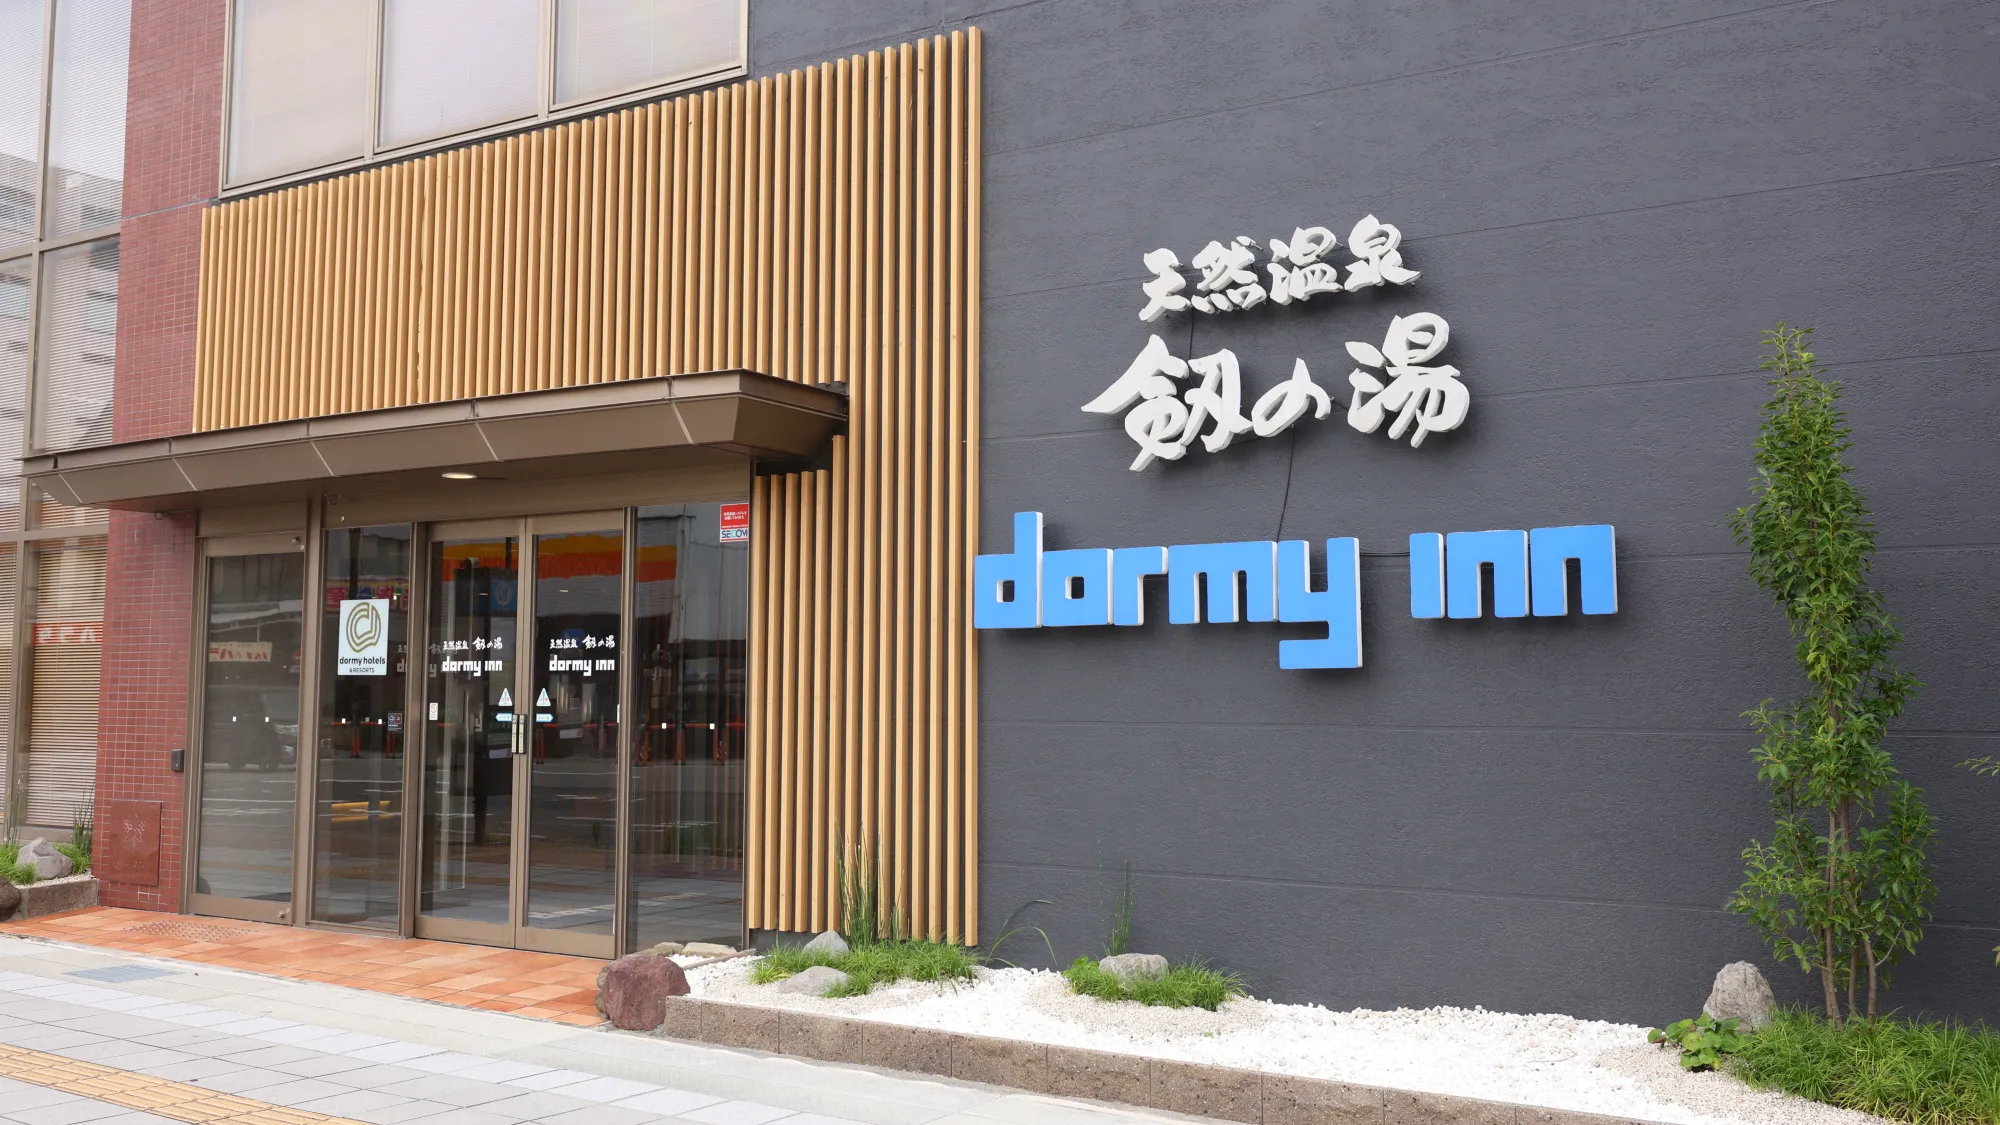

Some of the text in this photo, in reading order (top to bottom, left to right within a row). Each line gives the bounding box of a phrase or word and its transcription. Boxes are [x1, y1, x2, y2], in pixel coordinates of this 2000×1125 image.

[1138, 214, 1421, 322] 天然温泉
[721, 529, 748, 539] SECOM
[974, 511, 1619, 669] dormy inn
[339, 656, 386, 666] dormy hotels
[442, 656, 481, 677] dormy
[484, 660, 503, 671] inn
[549, 655, 615, 676] dormy inn
